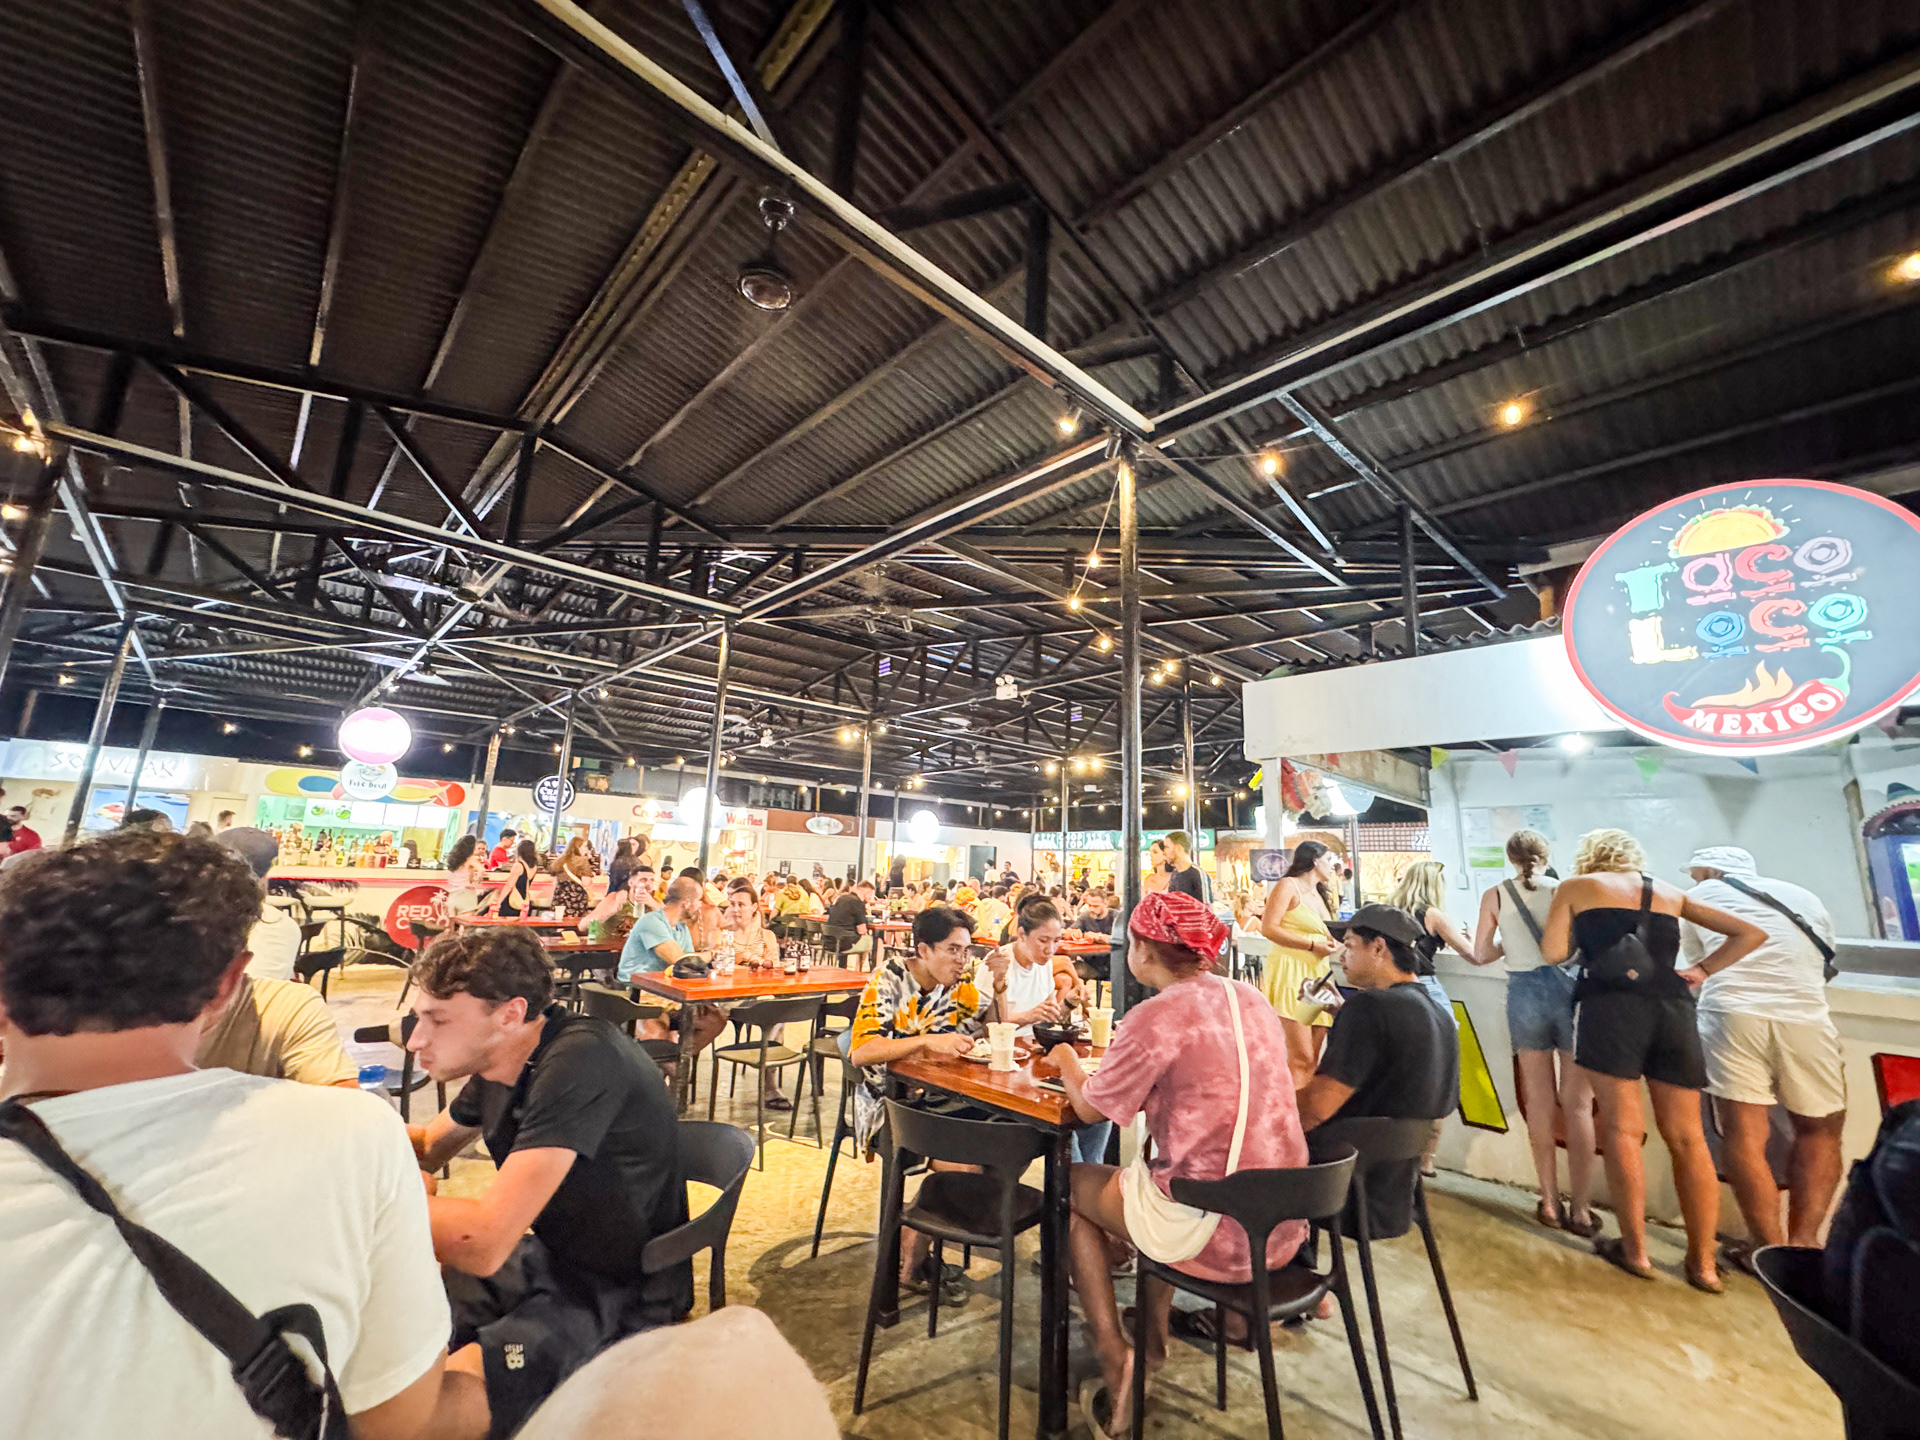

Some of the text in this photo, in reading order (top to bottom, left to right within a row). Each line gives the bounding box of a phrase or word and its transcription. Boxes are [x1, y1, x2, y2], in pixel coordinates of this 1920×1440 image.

[1683, 691, 1837, 735] MEXICO
[632, 804, 673, 819] Crpes
[396, 904, 433, 918] RED
[396, 916, 450, 930] CO
